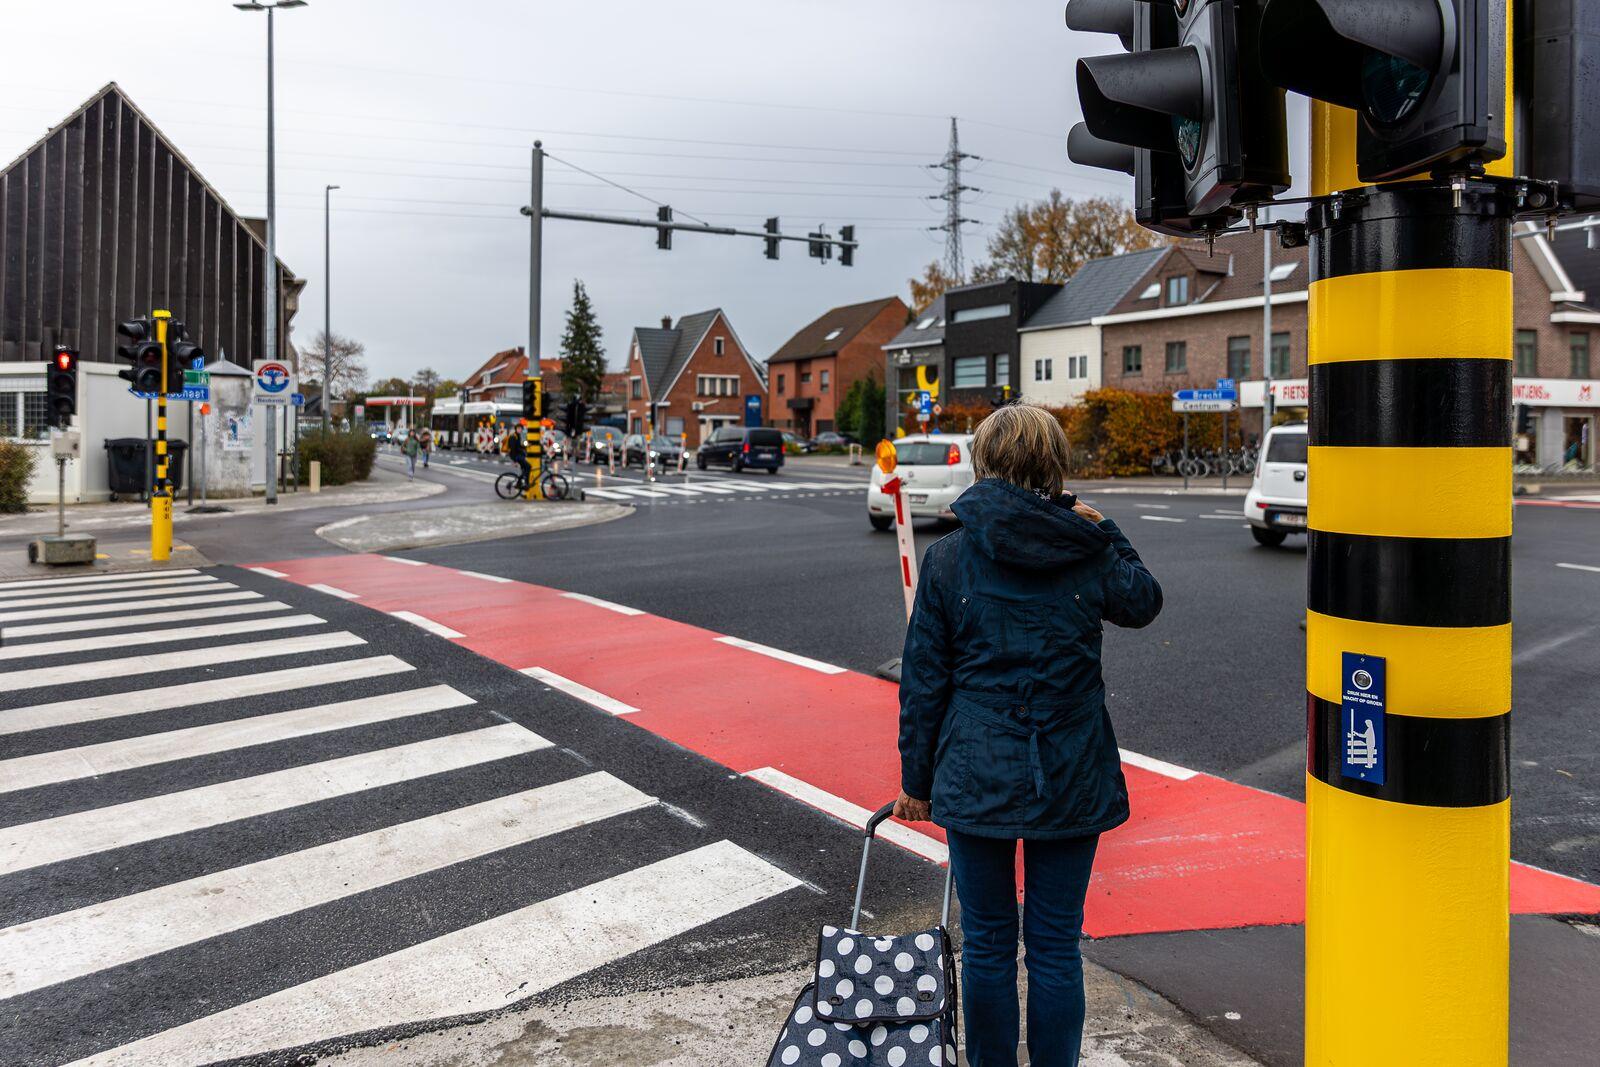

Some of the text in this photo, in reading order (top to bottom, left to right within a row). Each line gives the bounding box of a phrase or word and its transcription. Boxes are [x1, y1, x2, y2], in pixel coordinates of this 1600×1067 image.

[1193, 390, 1221, 400] Brecht
[1513, 385, 1543, 399] INTJENS
[1183, 402, 1219, 410] Centrum
